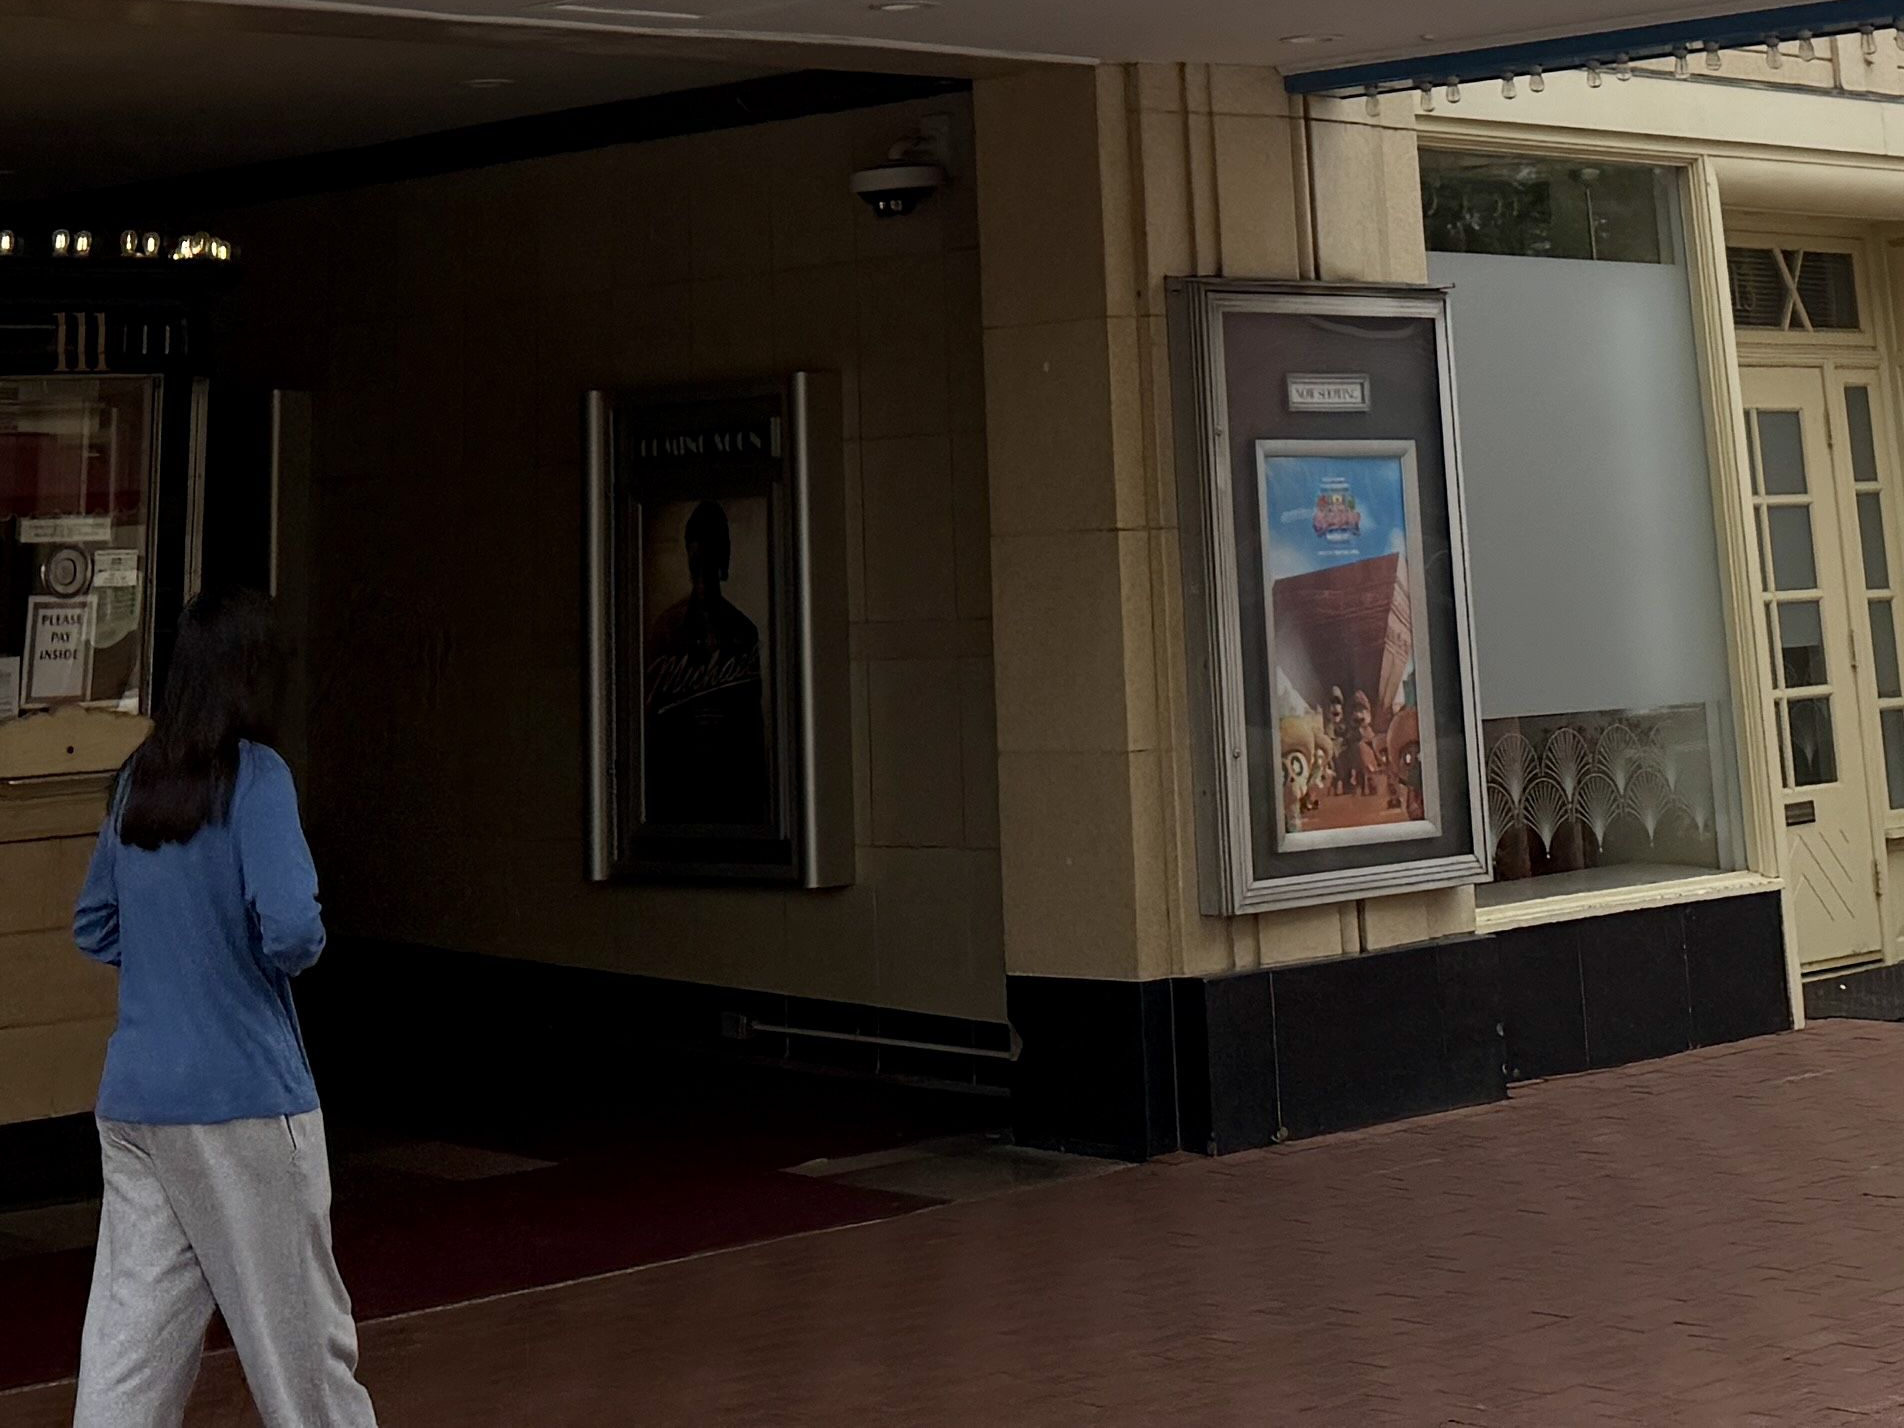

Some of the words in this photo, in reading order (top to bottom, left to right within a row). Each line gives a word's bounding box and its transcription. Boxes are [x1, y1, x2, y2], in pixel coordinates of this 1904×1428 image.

[41, 612, 82, 626] PLEASE
[50, 632, 71, 643] PAY
[39, 649, 79, 661] INSIDE
